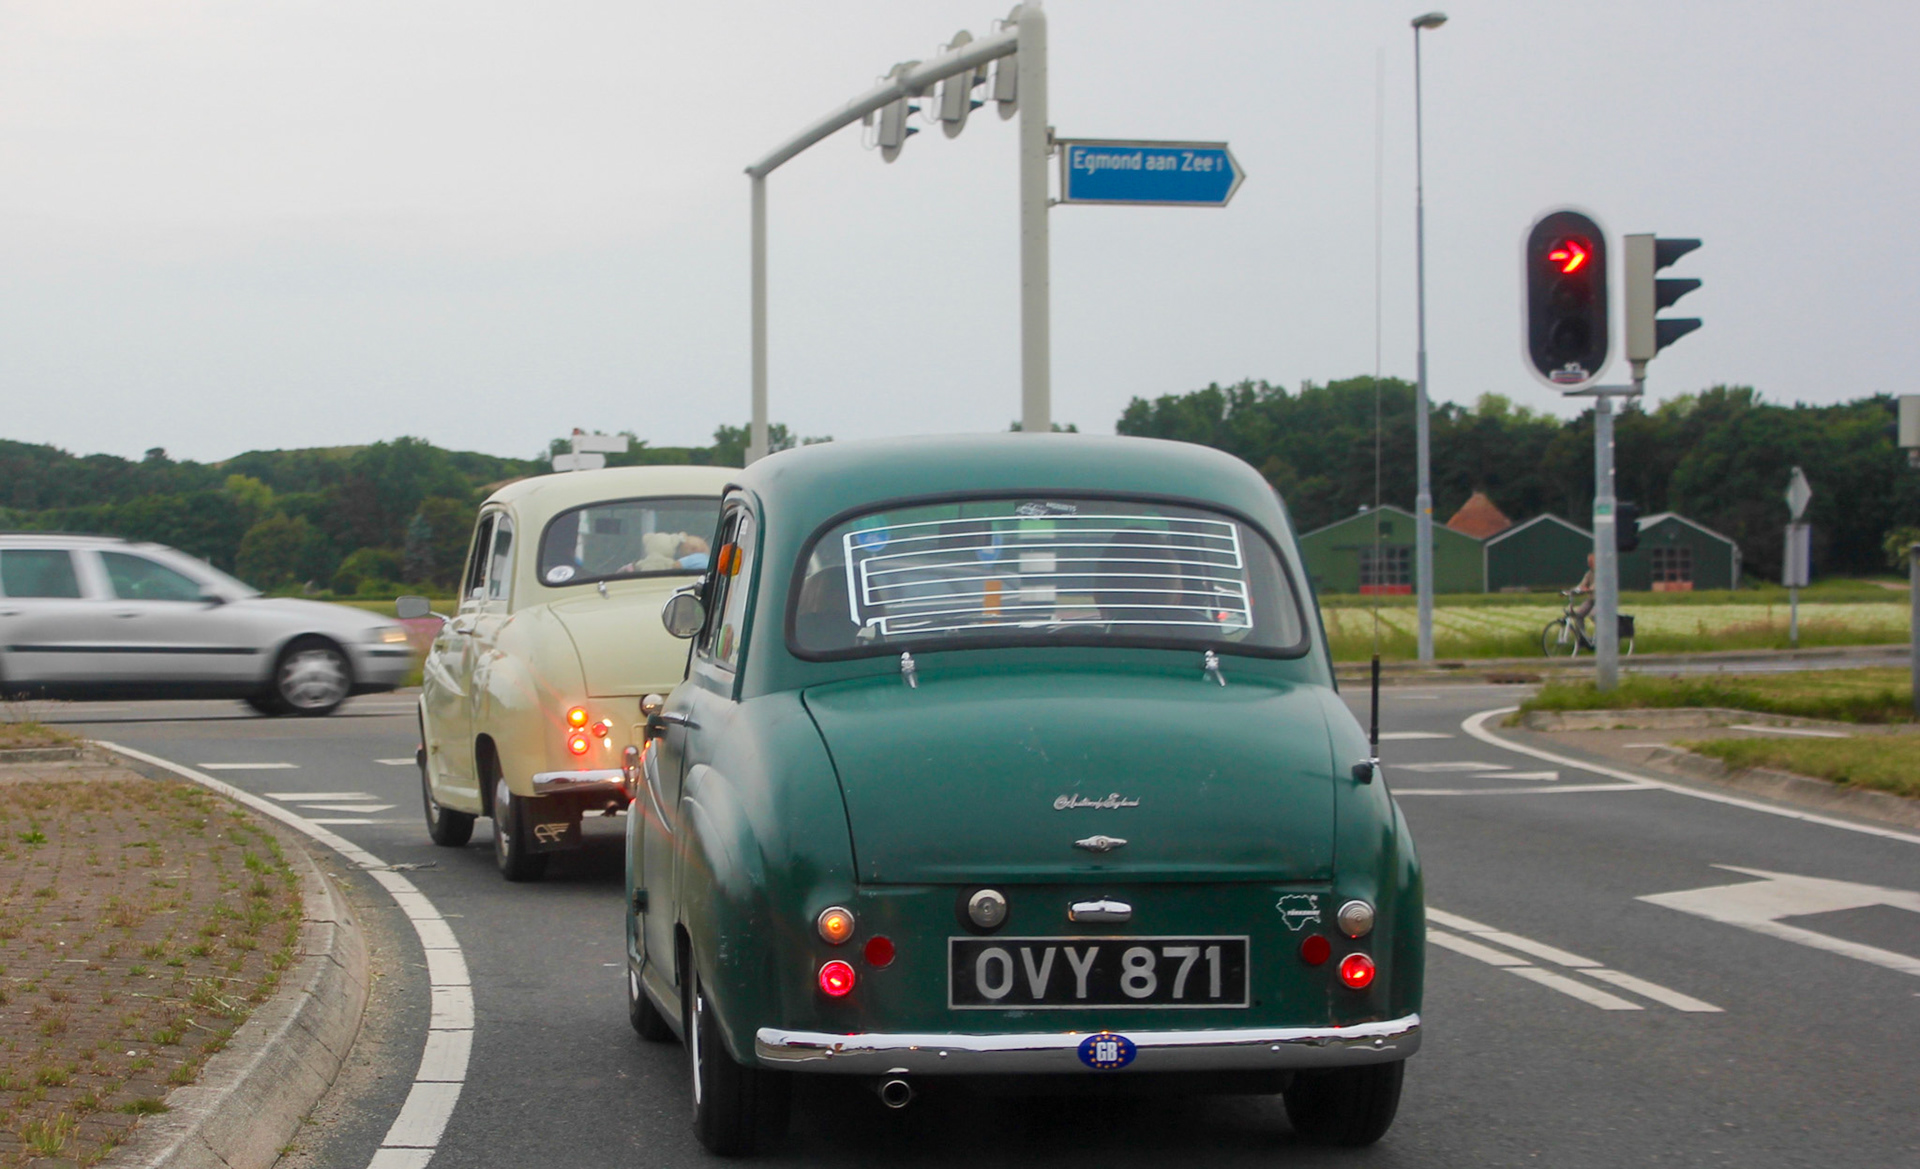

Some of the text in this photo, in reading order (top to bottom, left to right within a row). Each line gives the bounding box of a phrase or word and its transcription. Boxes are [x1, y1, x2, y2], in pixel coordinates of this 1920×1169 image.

[1073, 150, 1142, 175] Egmond
[1145, 155, 1177, 171] aan
[1181, 153, 1213, 172] Zee
[975, 945, 1221, 1000] OVY 871
[1096, 1041, 1118, 1062] GB
